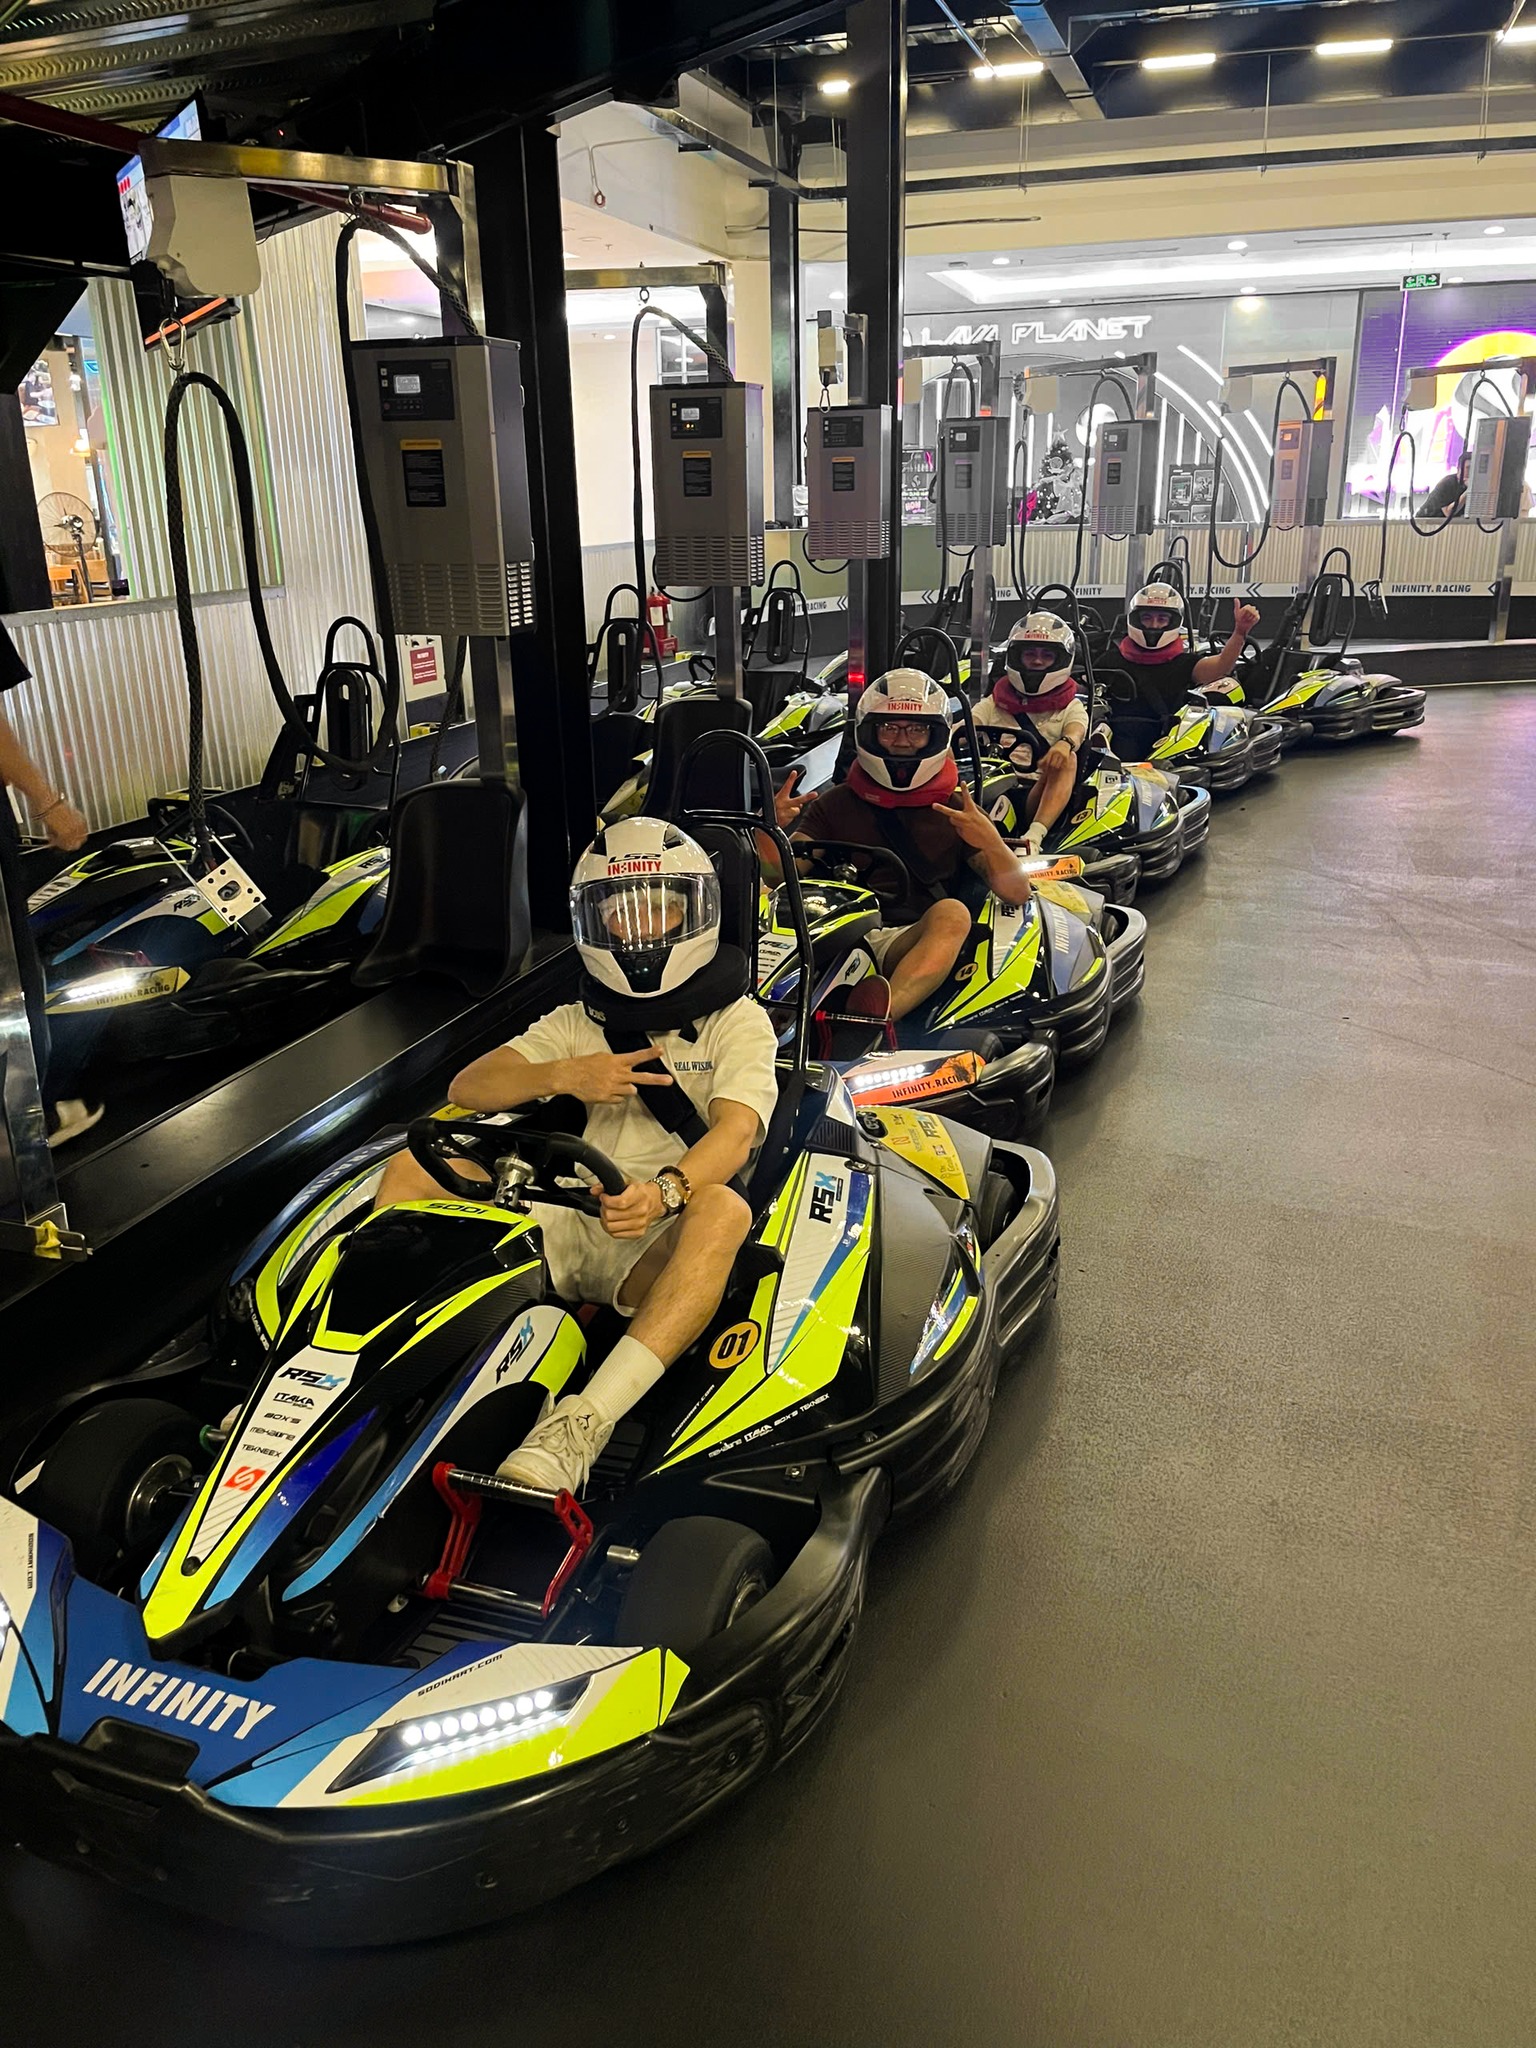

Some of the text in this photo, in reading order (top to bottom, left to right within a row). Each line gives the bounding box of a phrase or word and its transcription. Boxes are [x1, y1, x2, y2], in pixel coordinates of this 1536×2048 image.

[1011, 315, 1152, 344] PLANET
[1391, 584, 1472, 594] INFINITY.RACING
[809, 1171, 836, 1224] RSX
[496, 1315, 533, 1385] RSX
[717, 1330, 751, 1360] 01
[278, 1367, 346, 1387] RSX
[275, 1392, 315, 1406] ITAKA
[83, 1658, 276, 1740] INFINITY
